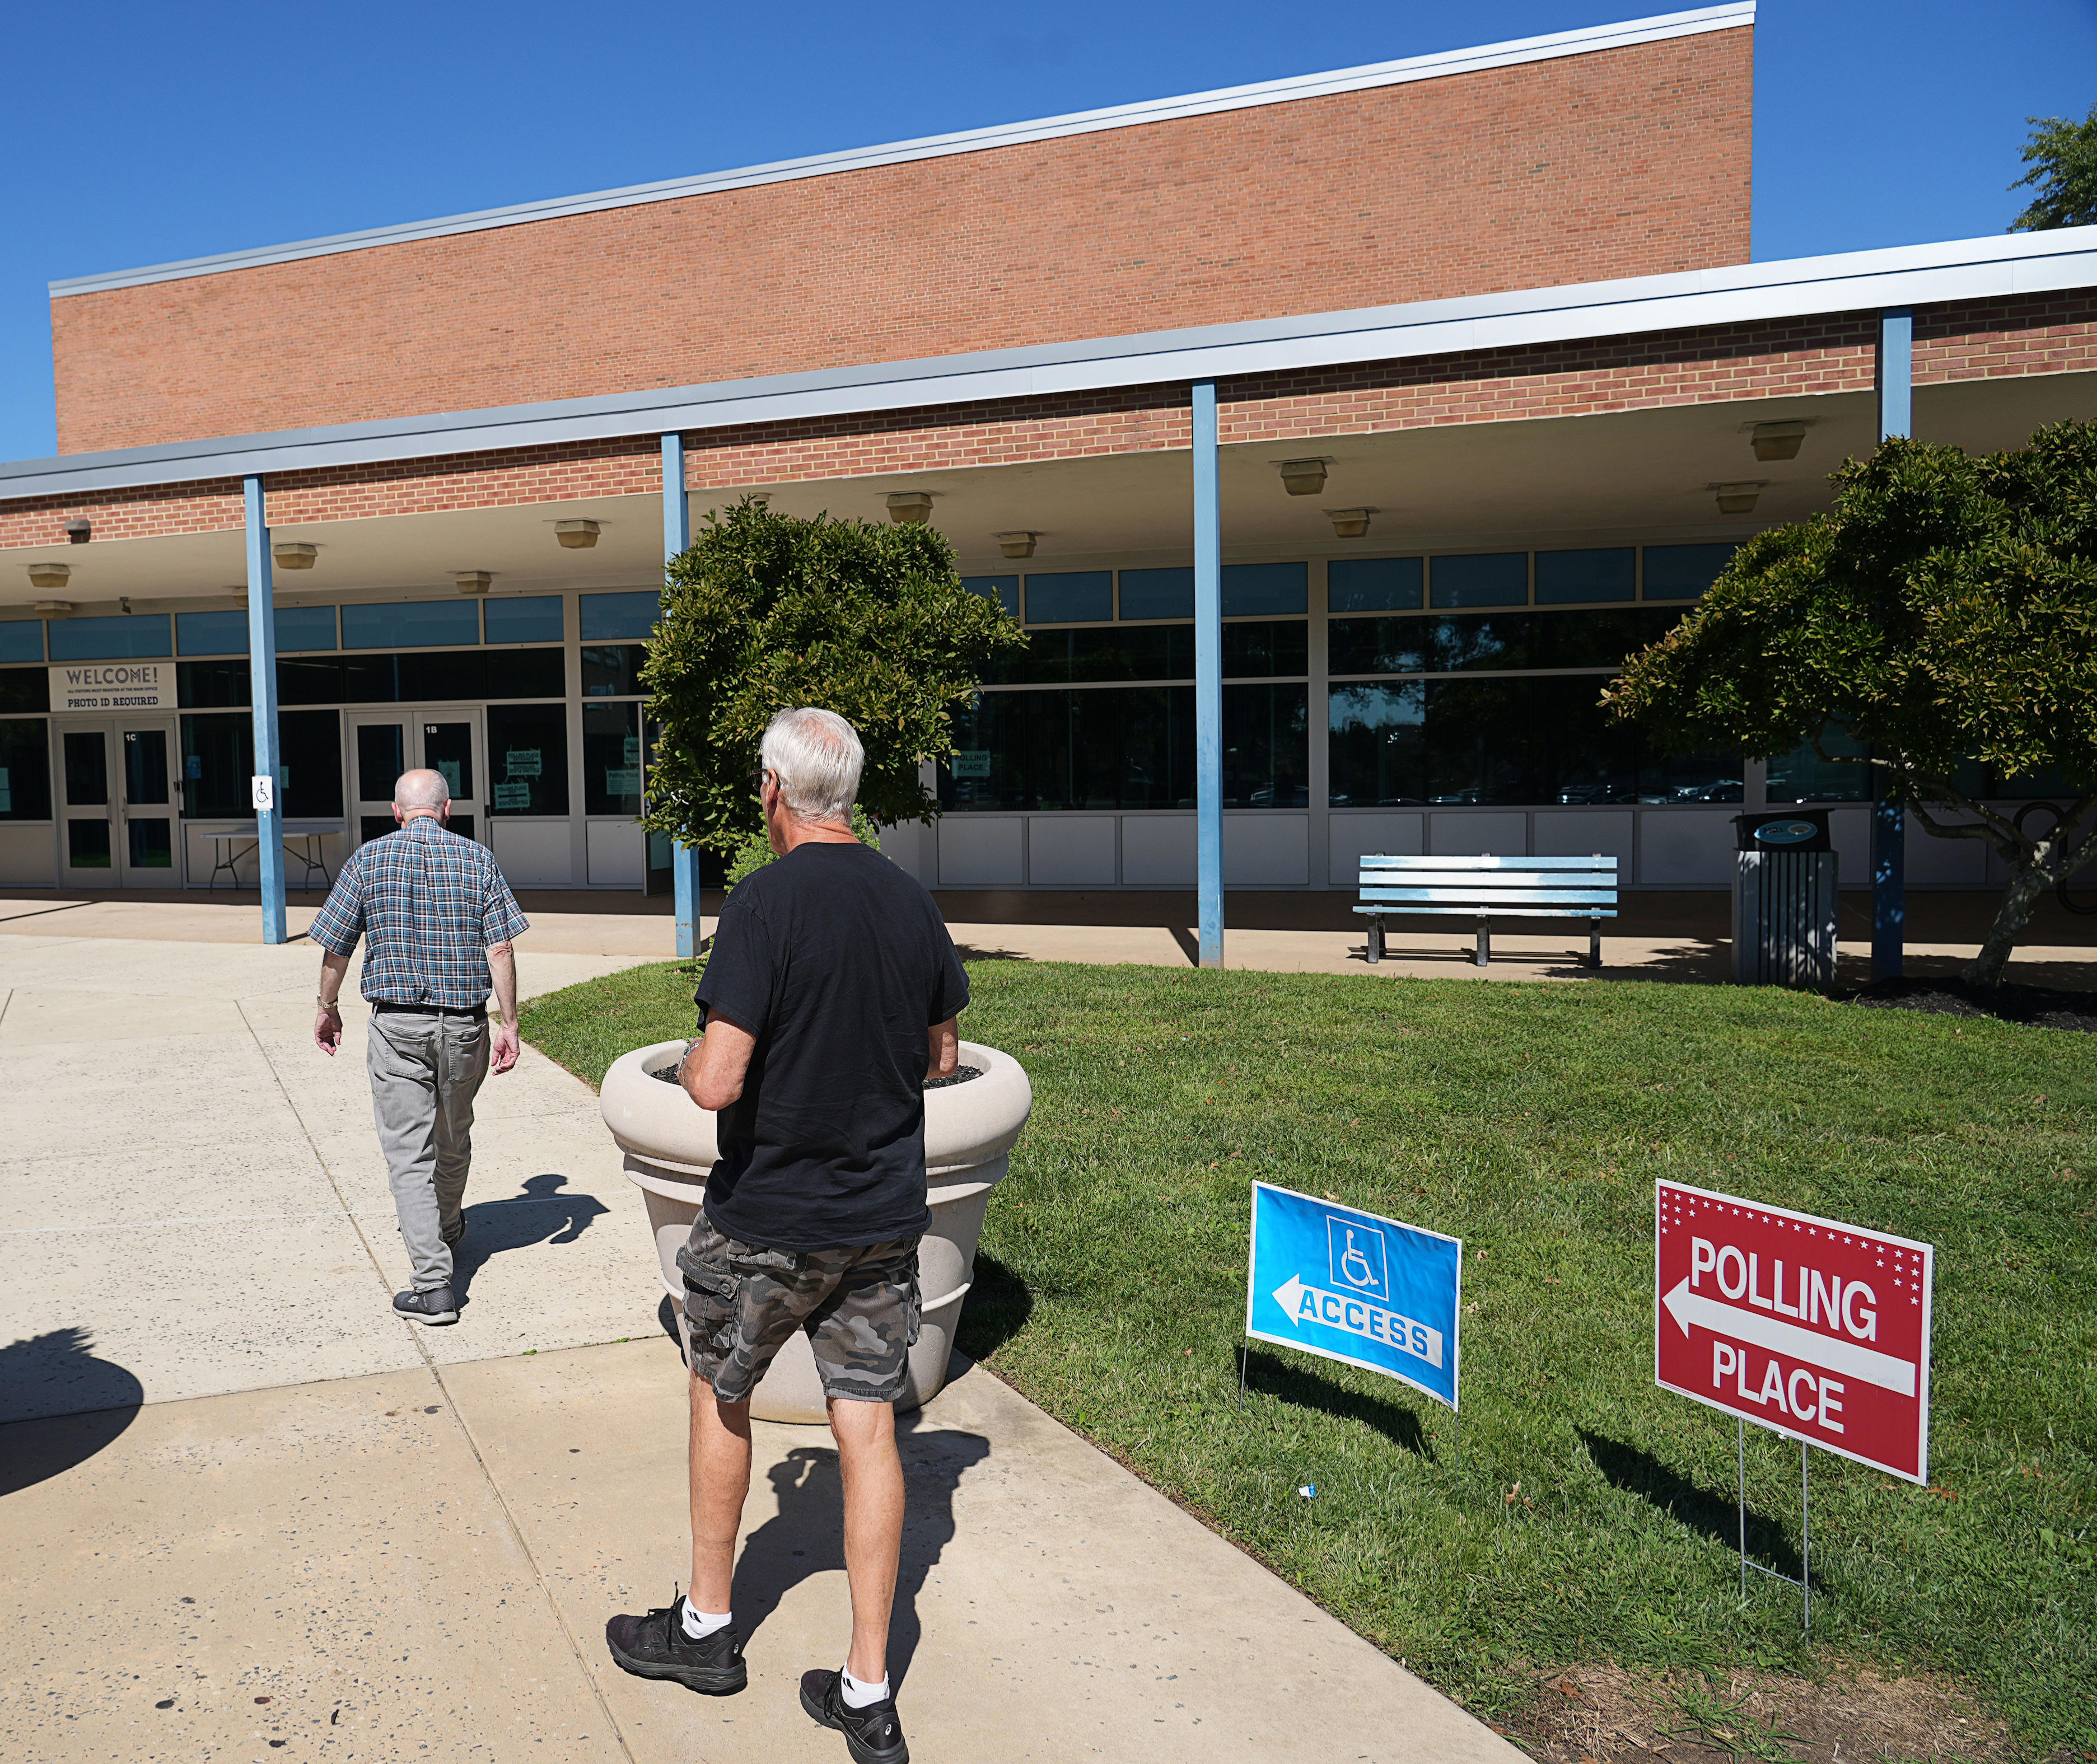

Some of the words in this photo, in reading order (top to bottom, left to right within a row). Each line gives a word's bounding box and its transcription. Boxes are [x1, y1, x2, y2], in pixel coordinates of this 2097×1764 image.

[67, 667, 157, 685] WELCOME!
[68, 699, 97, 708] PHOTO
[101, 698, 110, 706] ID
[113, 696, 158, 706] REQUIRED
[1692, 1236, 1876, 1342] POLLING
[1299, 1290, 1428, 1356] ACCESS
[1713, 1340, 1844, 1434] PLACE
